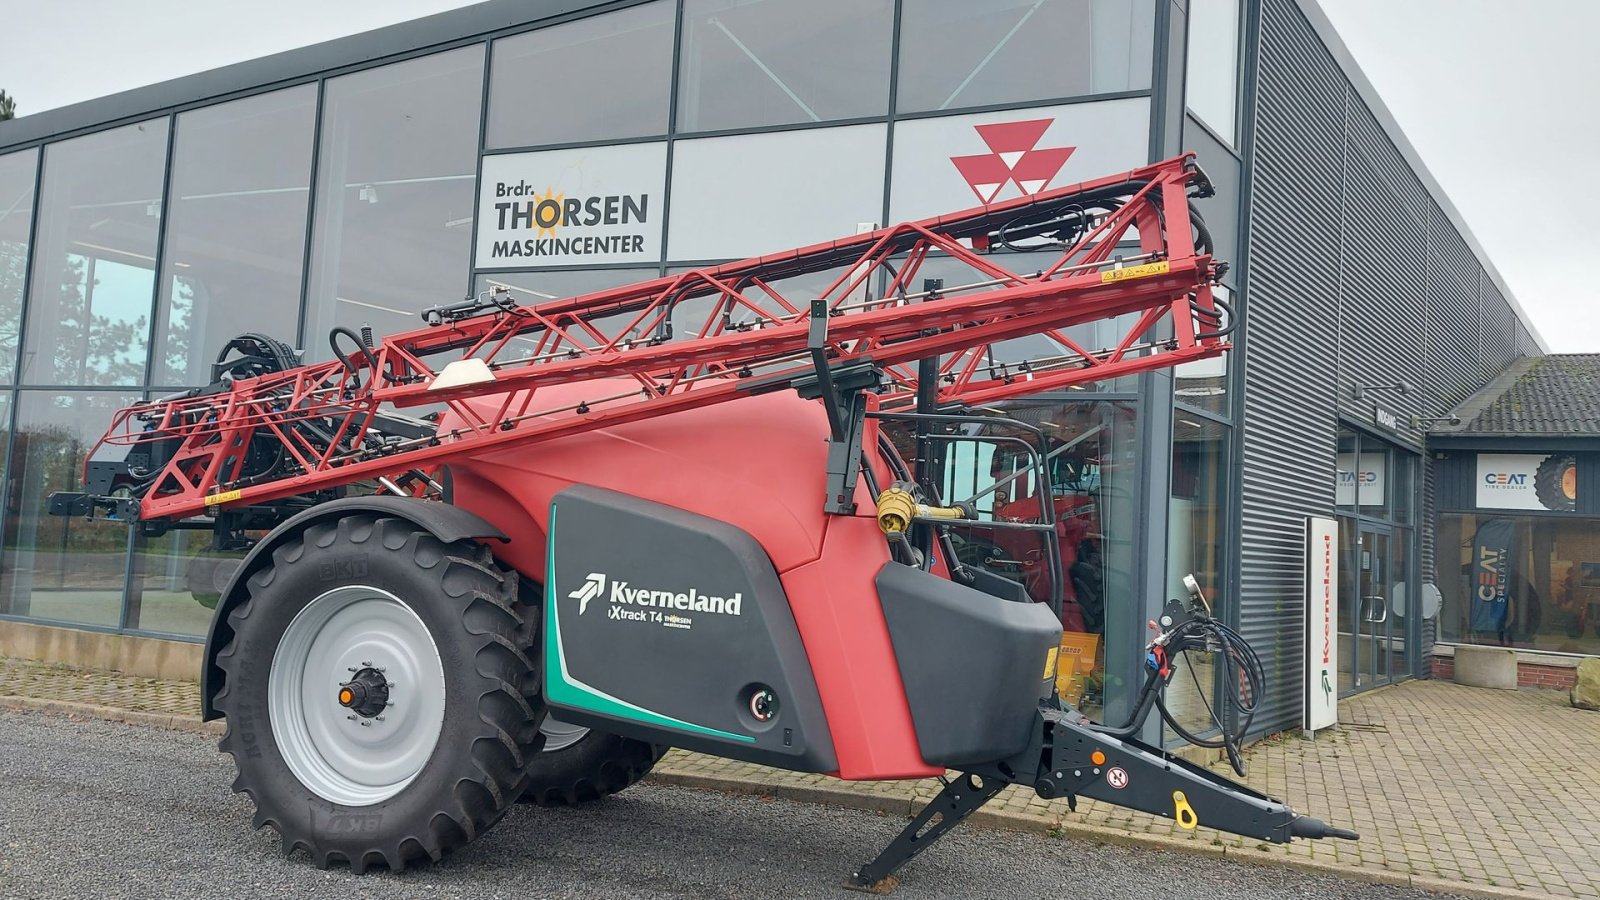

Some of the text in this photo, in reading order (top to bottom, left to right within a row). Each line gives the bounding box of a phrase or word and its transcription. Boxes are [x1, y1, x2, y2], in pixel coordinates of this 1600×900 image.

[496, 180, 535, 197] Brdr.
[495, 194, 648, 230] THORSEN
[492, 235, 644, 258] MASKINCENTER
[1485, 473, 1527, 484] CEAT
[1478, 545, 1498, 602] CEAT
[1497, 548, 1507, 603] SPECIALTY
[607, 605, 663, 623] iXtrack T4
[609, 581, 742, 616] Kverneland
[1323, 535, 1331, 663] Kverneland
